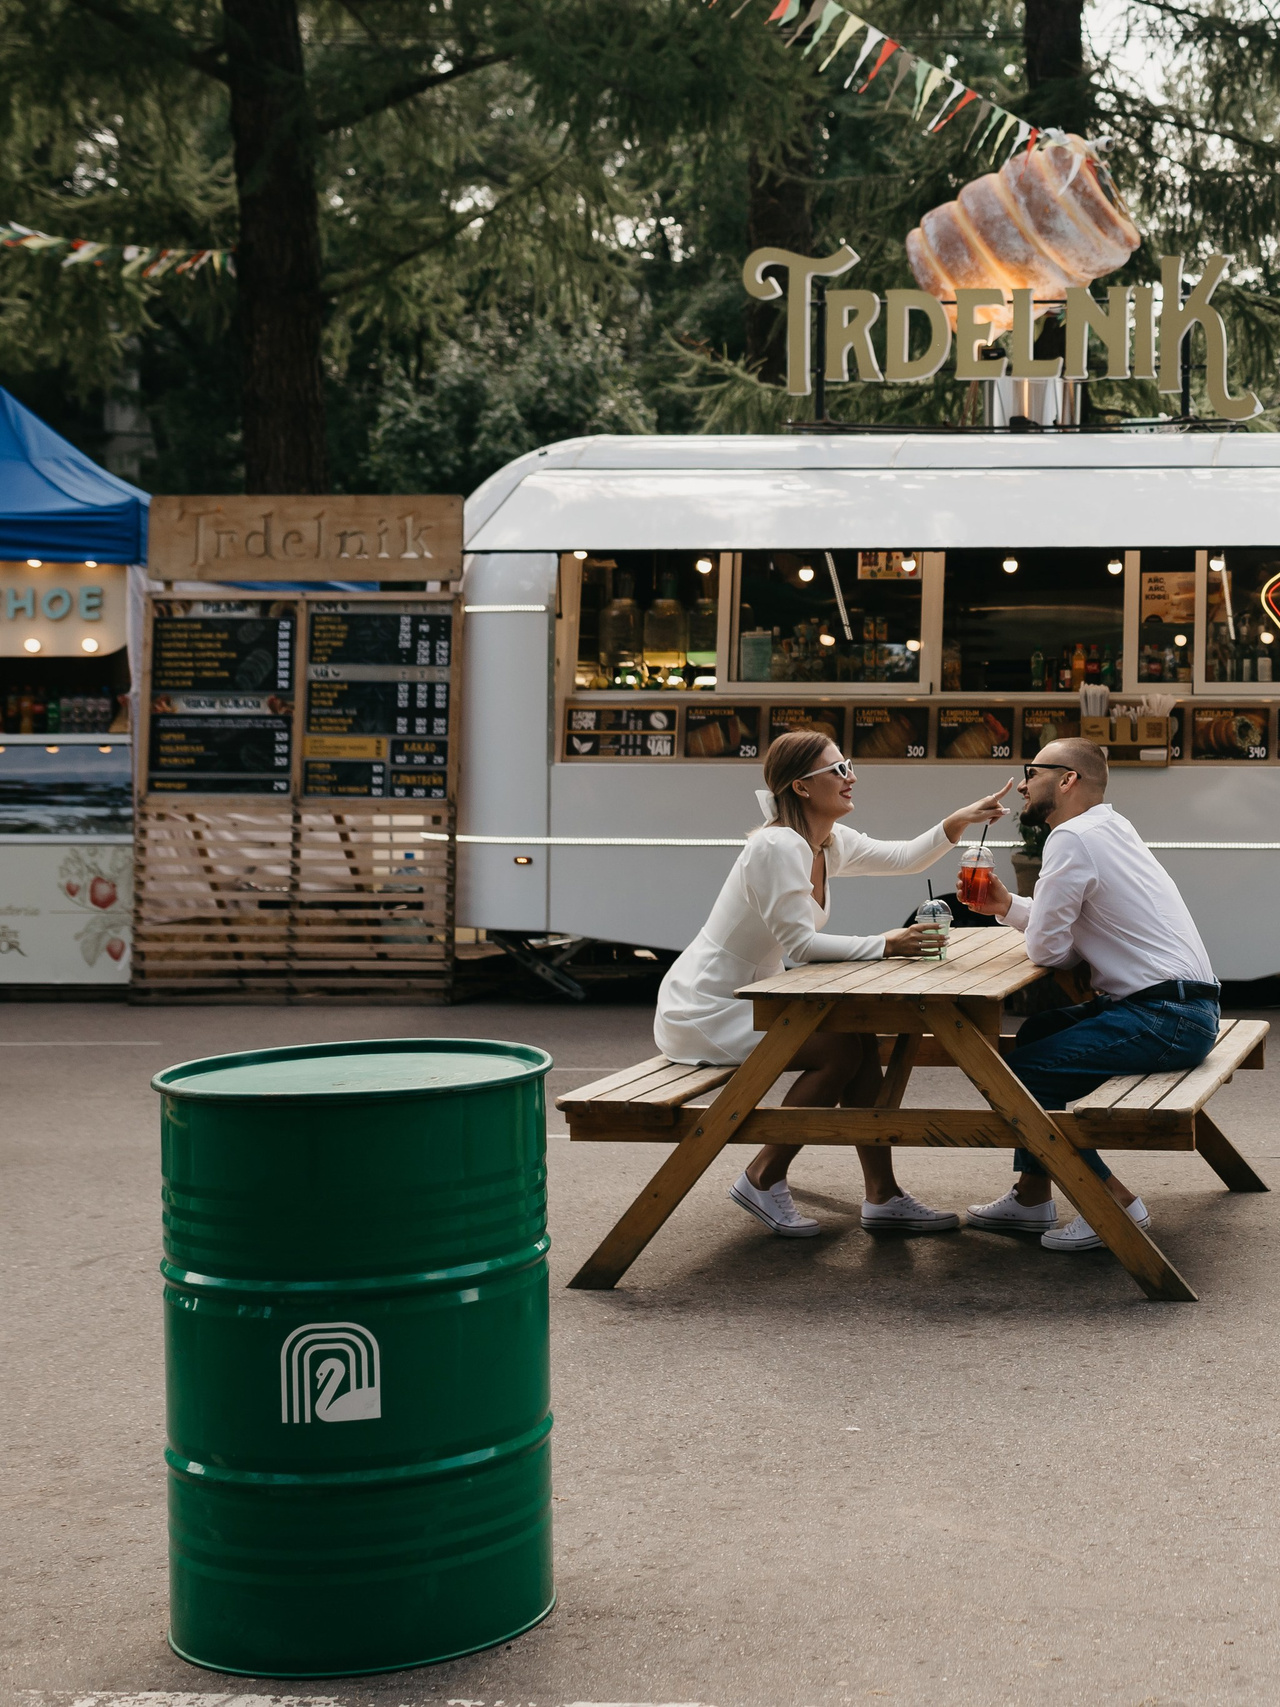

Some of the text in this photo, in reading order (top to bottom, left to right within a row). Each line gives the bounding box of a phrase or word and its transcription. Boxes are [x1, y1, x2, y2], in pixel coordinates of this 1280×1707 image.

[743, 243, 1264, 421] TRDELNIK
[178, 507, 433, 567] Trdelnik
[2, 585, 104, 621] НОЕ
[739, 744, 757, 757] 250
[907, 745, 924, 757] 300
[992, 745, 1010, 757] 300
[1248, 746, 1266, 758] 340
